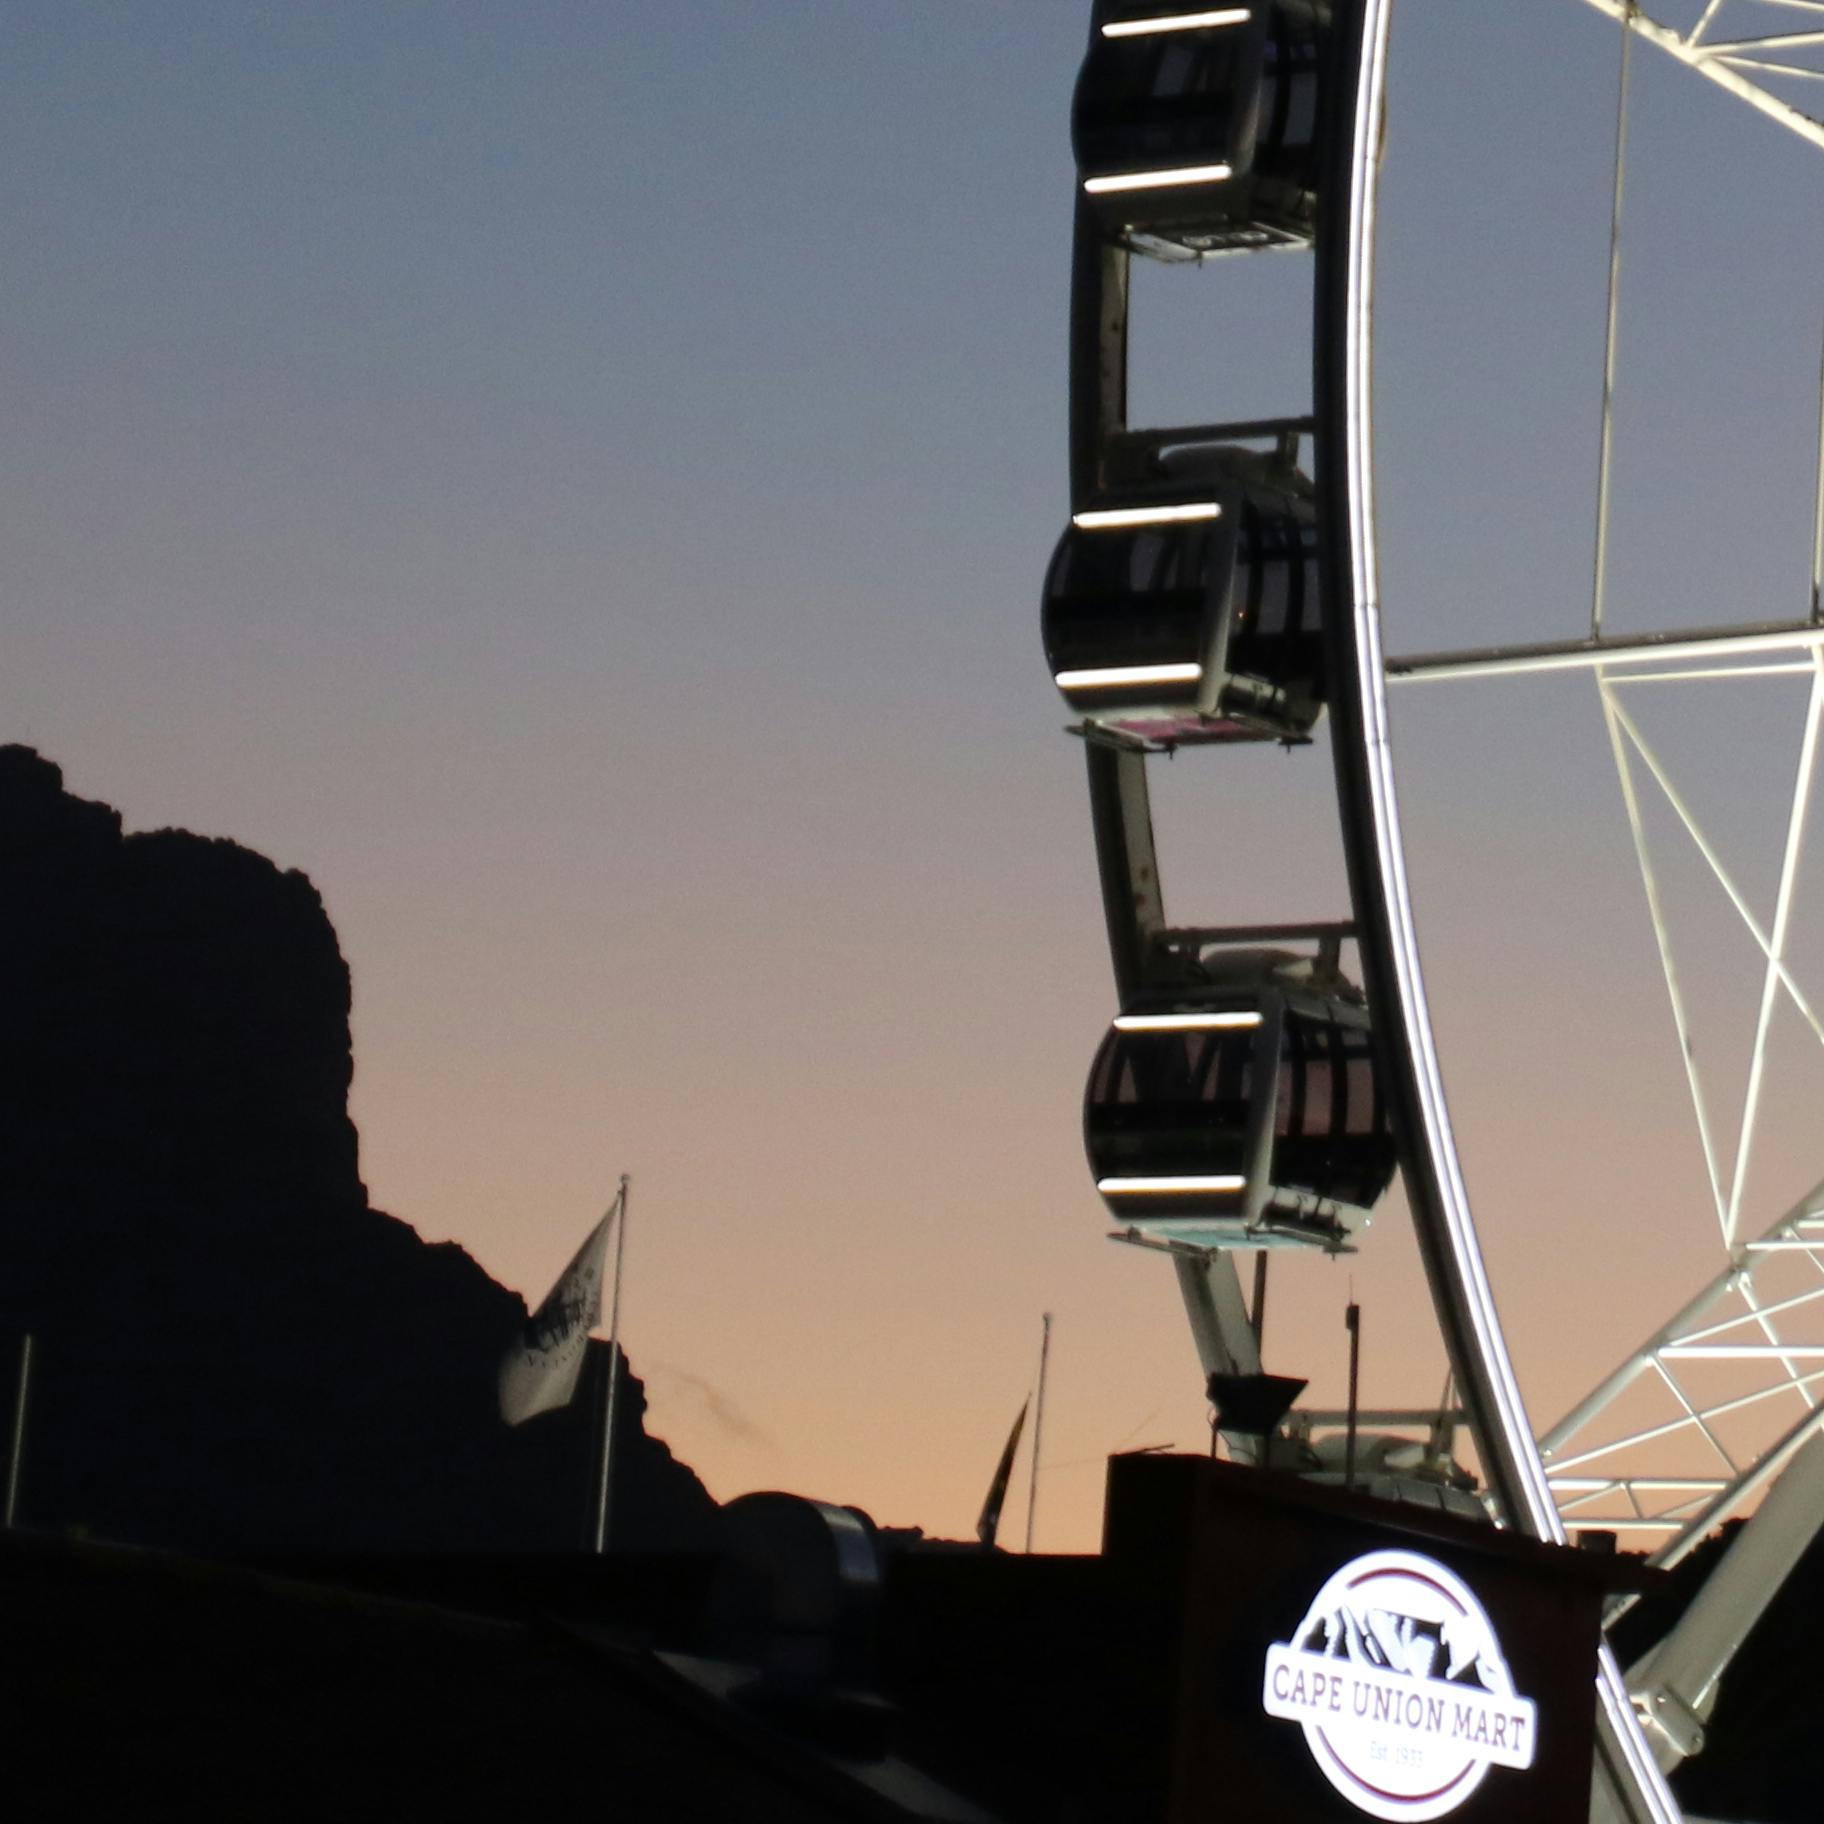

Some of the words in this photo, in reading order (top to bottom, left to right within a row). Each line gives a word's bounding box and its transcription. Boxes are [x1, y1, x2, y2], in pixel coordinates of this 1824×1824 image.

[1272, 1663, 1344, 1713] CAPE
[1353, 1680, 1445, 1733] UNION
[1451, 1702, 1526, 1752] MART
